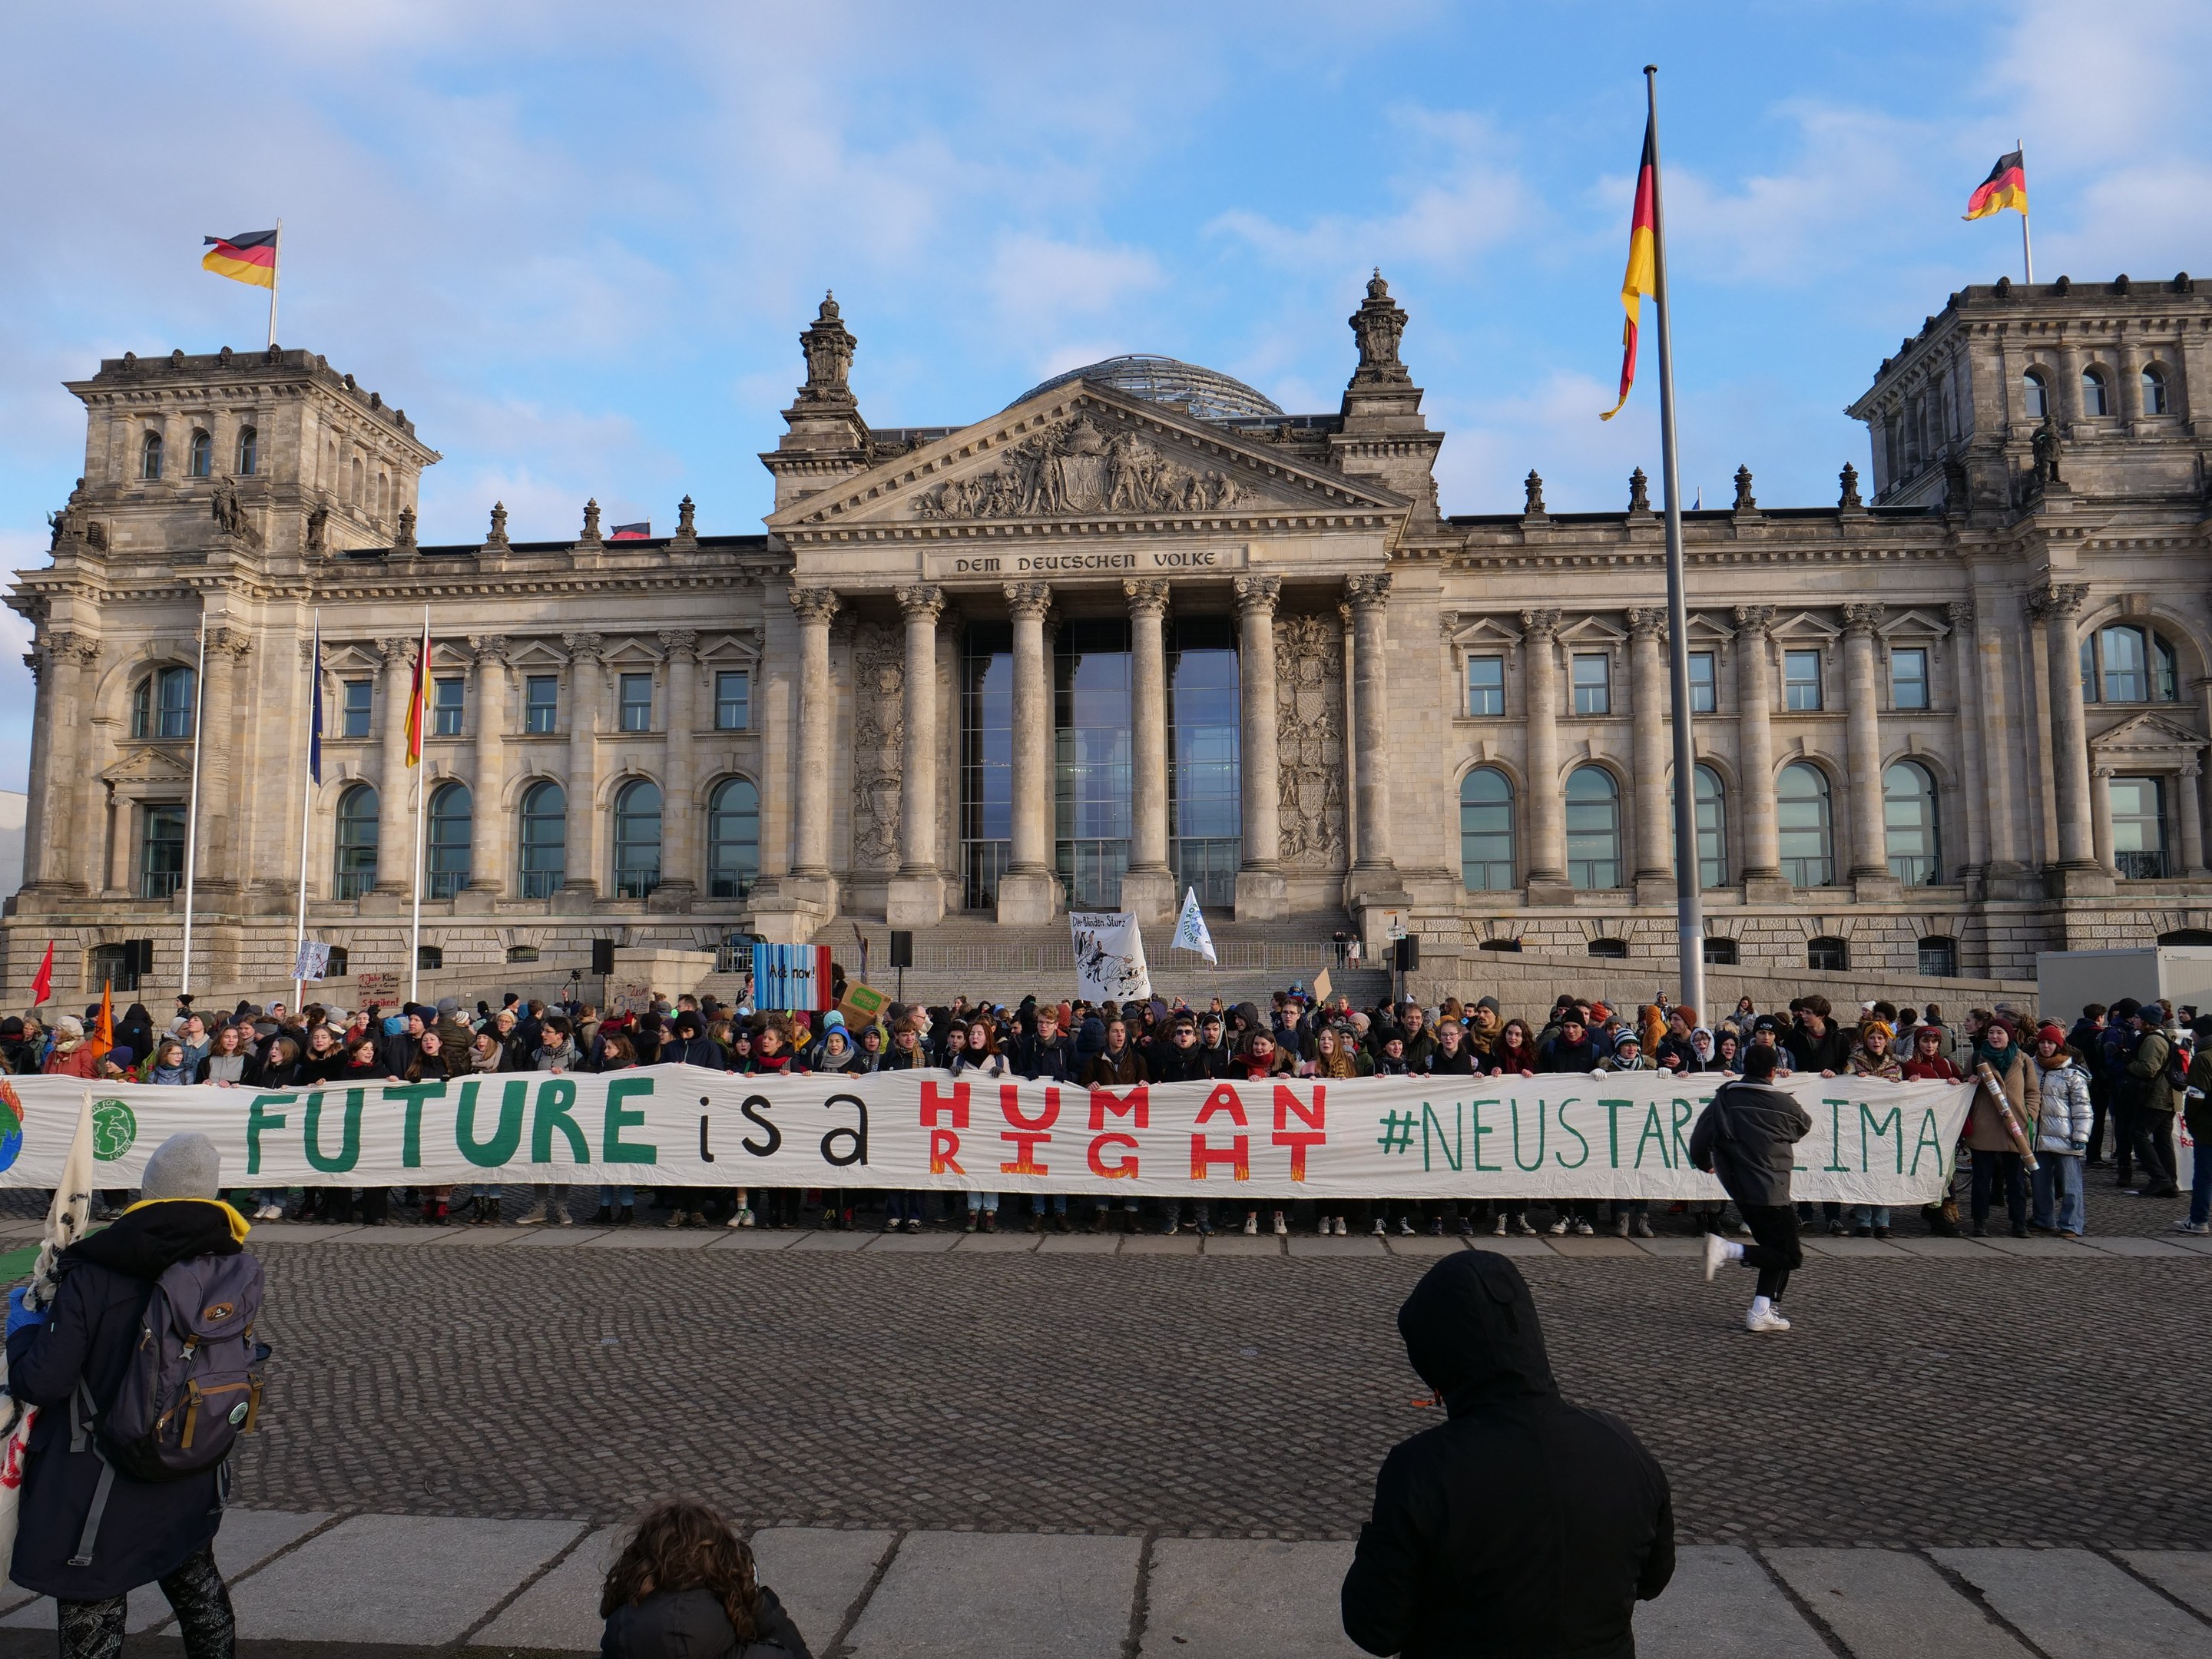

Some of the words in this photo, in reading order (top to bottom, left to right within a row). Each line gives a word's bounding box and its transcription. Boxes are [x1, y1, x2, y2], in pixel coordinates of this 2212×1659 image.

[956, 558, 1001, 572] DEM
[1018, 555, 1136, 571] DEUTSCHEN
[1154, 552, 1216, 567] VOLKE
[1072, 916, 1082, 927] Der
[1107, 916, 1126, 927] Sturz
[365, 974, 382, 985] Jahr
[770, 964, 787, 979] Act
[793, 966, 815, 979] now!
[920, 1081, 1326, 1131] HUMAN
[247, 1078, 656, 1175] FUTURE
[700, 1095, 781, 1162] is
[821, 1094, 868, 1166] a
[109, 1139, 134, 1161] FUTURE
[930, 1129, 1326, 1182] RIGHT
